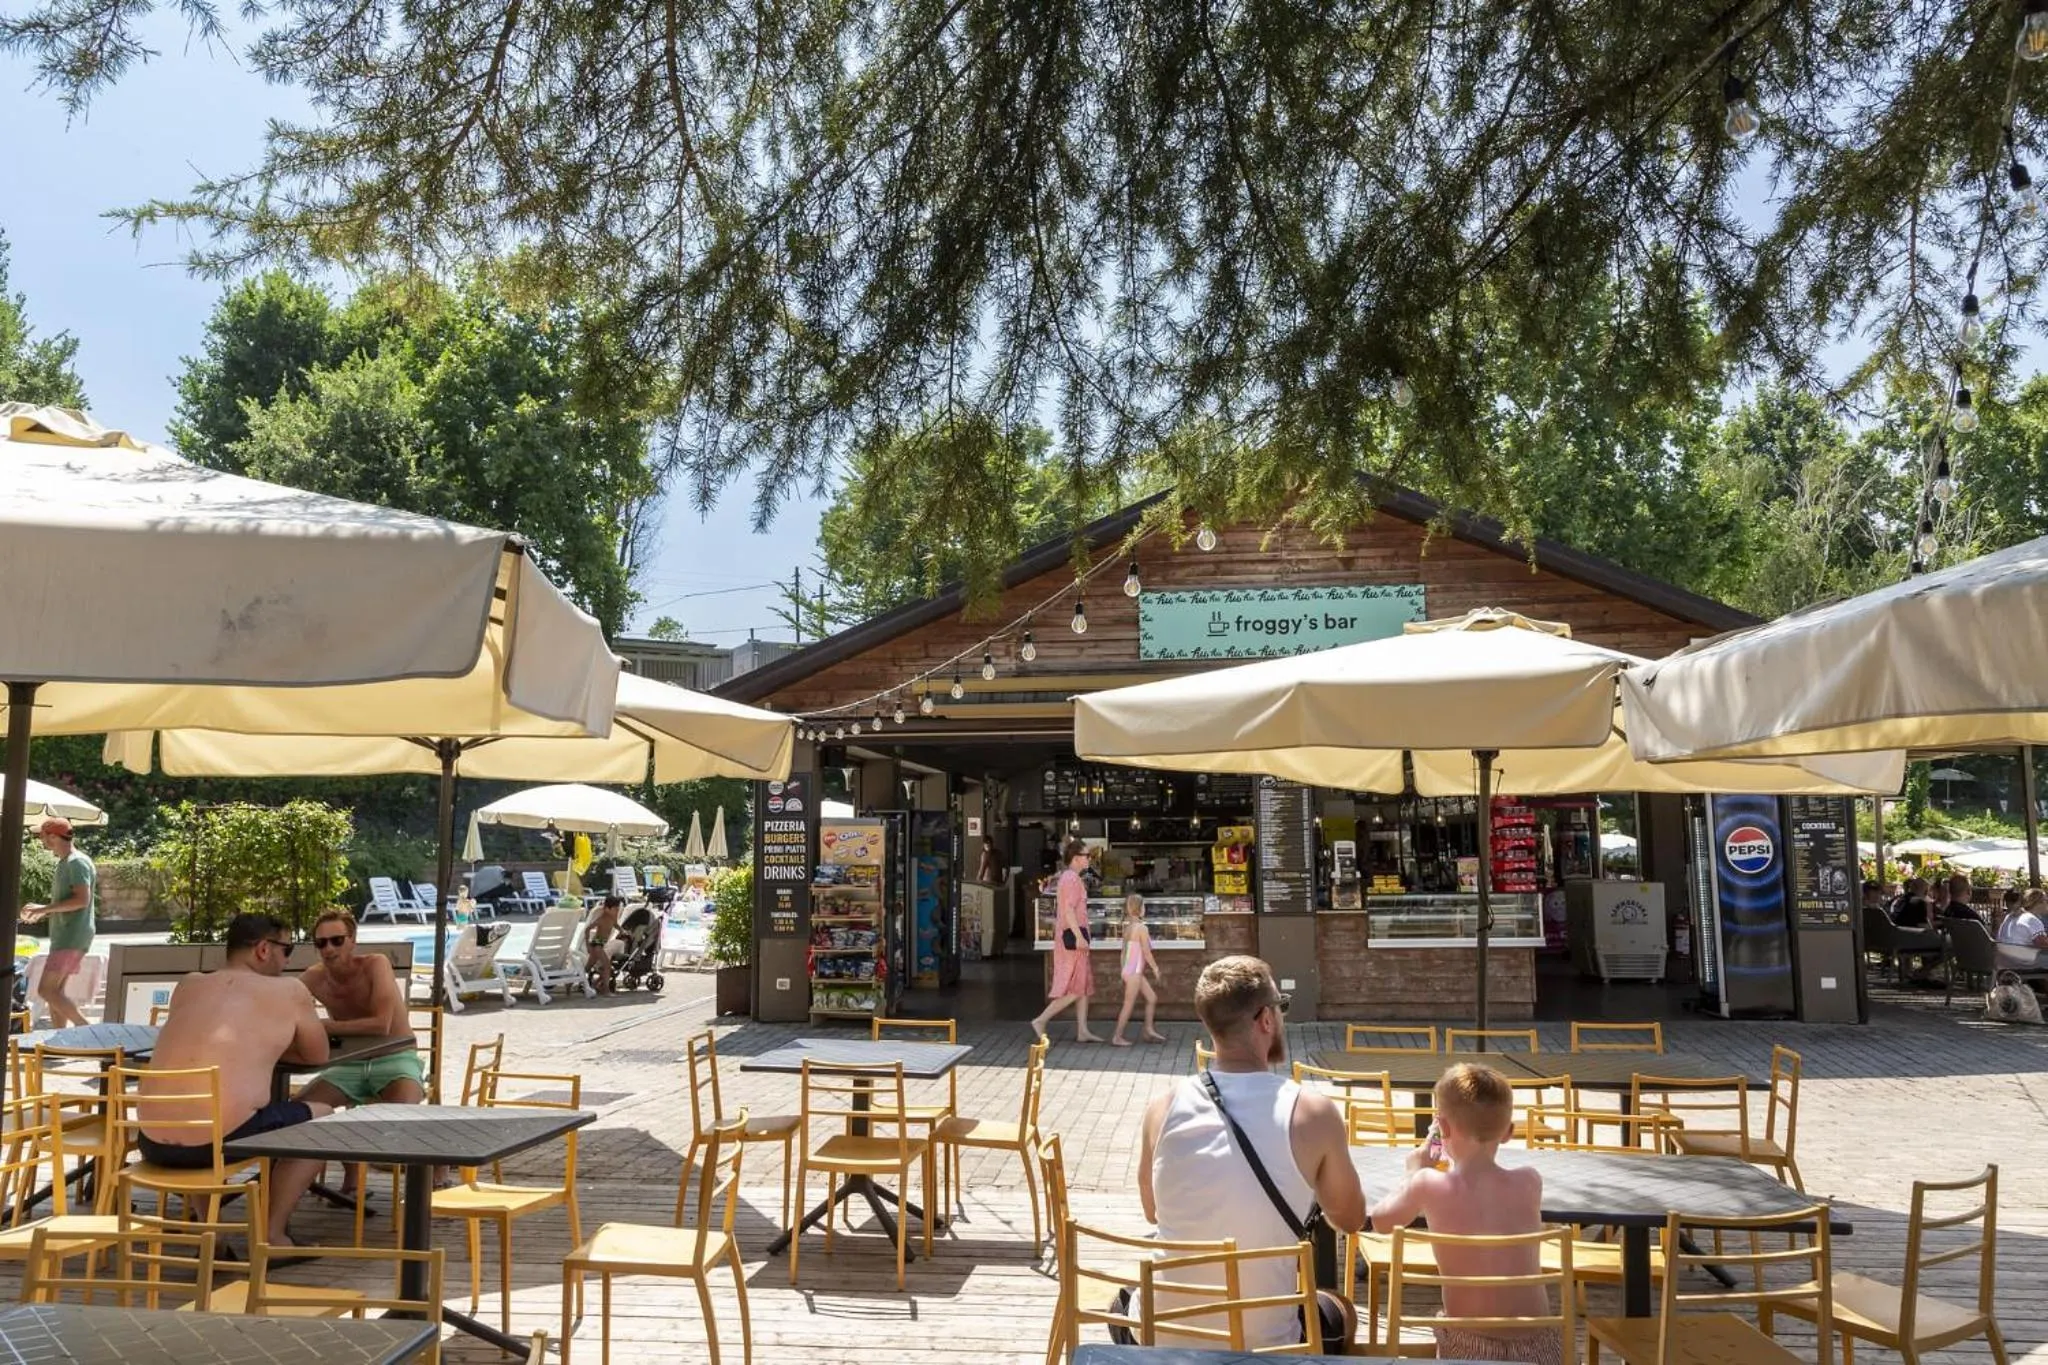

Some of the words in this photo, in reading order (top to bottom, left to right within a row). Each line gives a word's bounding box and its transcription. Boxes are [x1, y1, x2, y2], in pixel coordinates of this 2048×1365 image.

[1235, 613, 1318, 635] froggy's
[1324, 612, 1358, 630] bar
[764, 820, 805, 832] PIZZERIA
[764, 833, 806, 844] BURGERS
[1729, 844, 1770, 856] PEPSI
[764, 855, 805, 864] COCKTAILS
[764, 865, 805, 880] DRINKS
